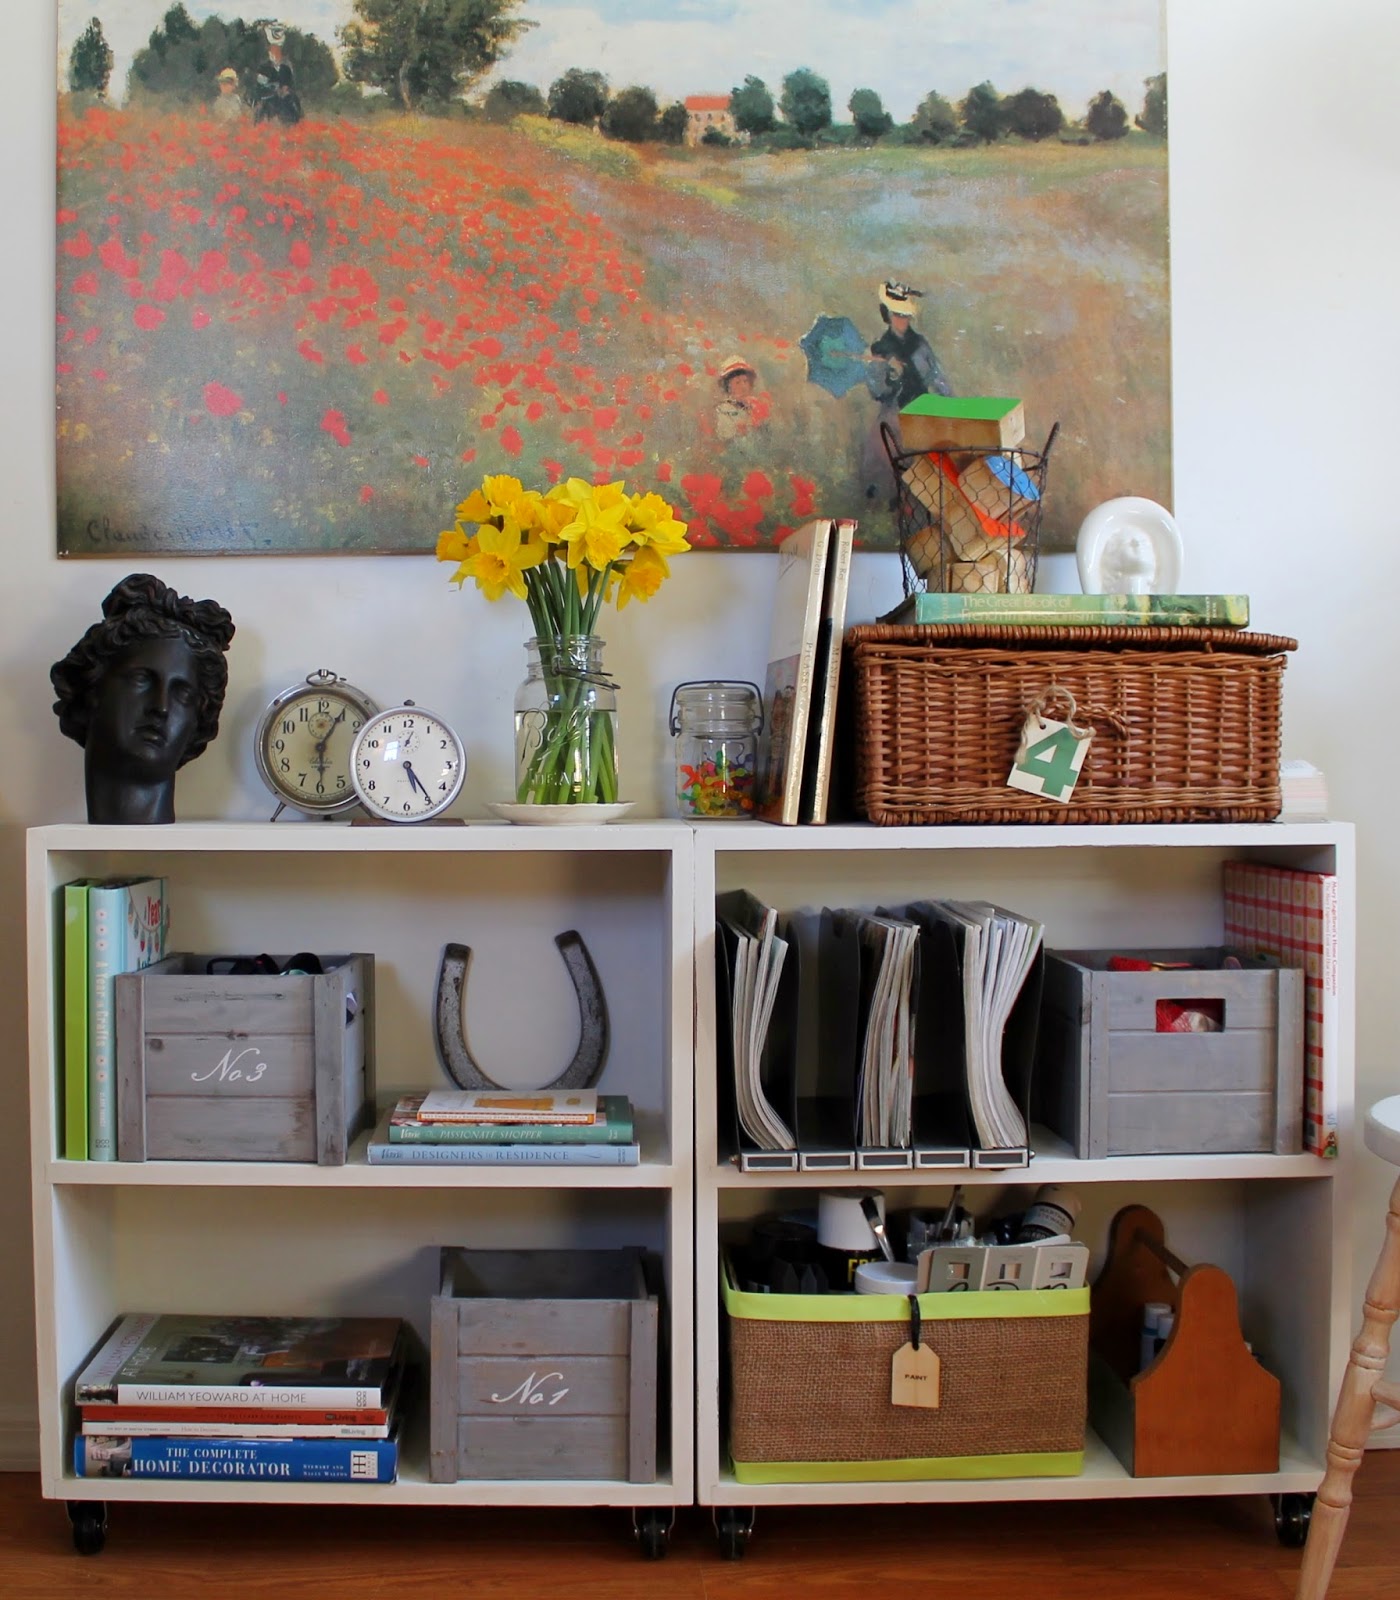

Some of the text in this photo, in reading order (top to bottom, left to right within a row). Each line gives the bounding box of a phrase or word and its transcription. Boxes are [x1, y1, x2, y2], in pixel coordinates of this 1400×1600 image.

[801, 642, 813, 694] PICASSO
[319, 701, 329, 714] 12
[300, 708, 308, 722] 11
[283, 720, 295, 734] 10
[384, 725, 391, 733] 11
[403, 719, 414, 728] 12
[276, 739, 285, 754] 9
[368, 740, 379, 748] 10
[440, 740, 447, 749] 2
[281, 757, 290, 772] 8
[363, 759, 370, 769] 9
[445, 760, 452, 769] 3
[1015, 727, 1078, 797] 4
[298, 773, 307, 786] 7
[336, 775, 345, 788] 5
[368, 780, 375, 790] 8
[438, 781, 446, 790] 4
[316, 780, 325, 793] 6
[403, 801, 410, 811] 6
[95, 973, 109, 997] Year
[95, 1010, 110, 1048] Crafts
[500, 1130, 542, 1139] SHOPPER
[412, 1150, 483, 1160] DESIGNERS
[495, 1150, 570, 1161] RESIDENCE
[136, 1391, 306, 1403] WILLIAM YEOWARD AT HOME
[165, 1448, 257, 1460] THE COMPLETE
[133, 1459, 291, 1475] HOME DECORATOR
